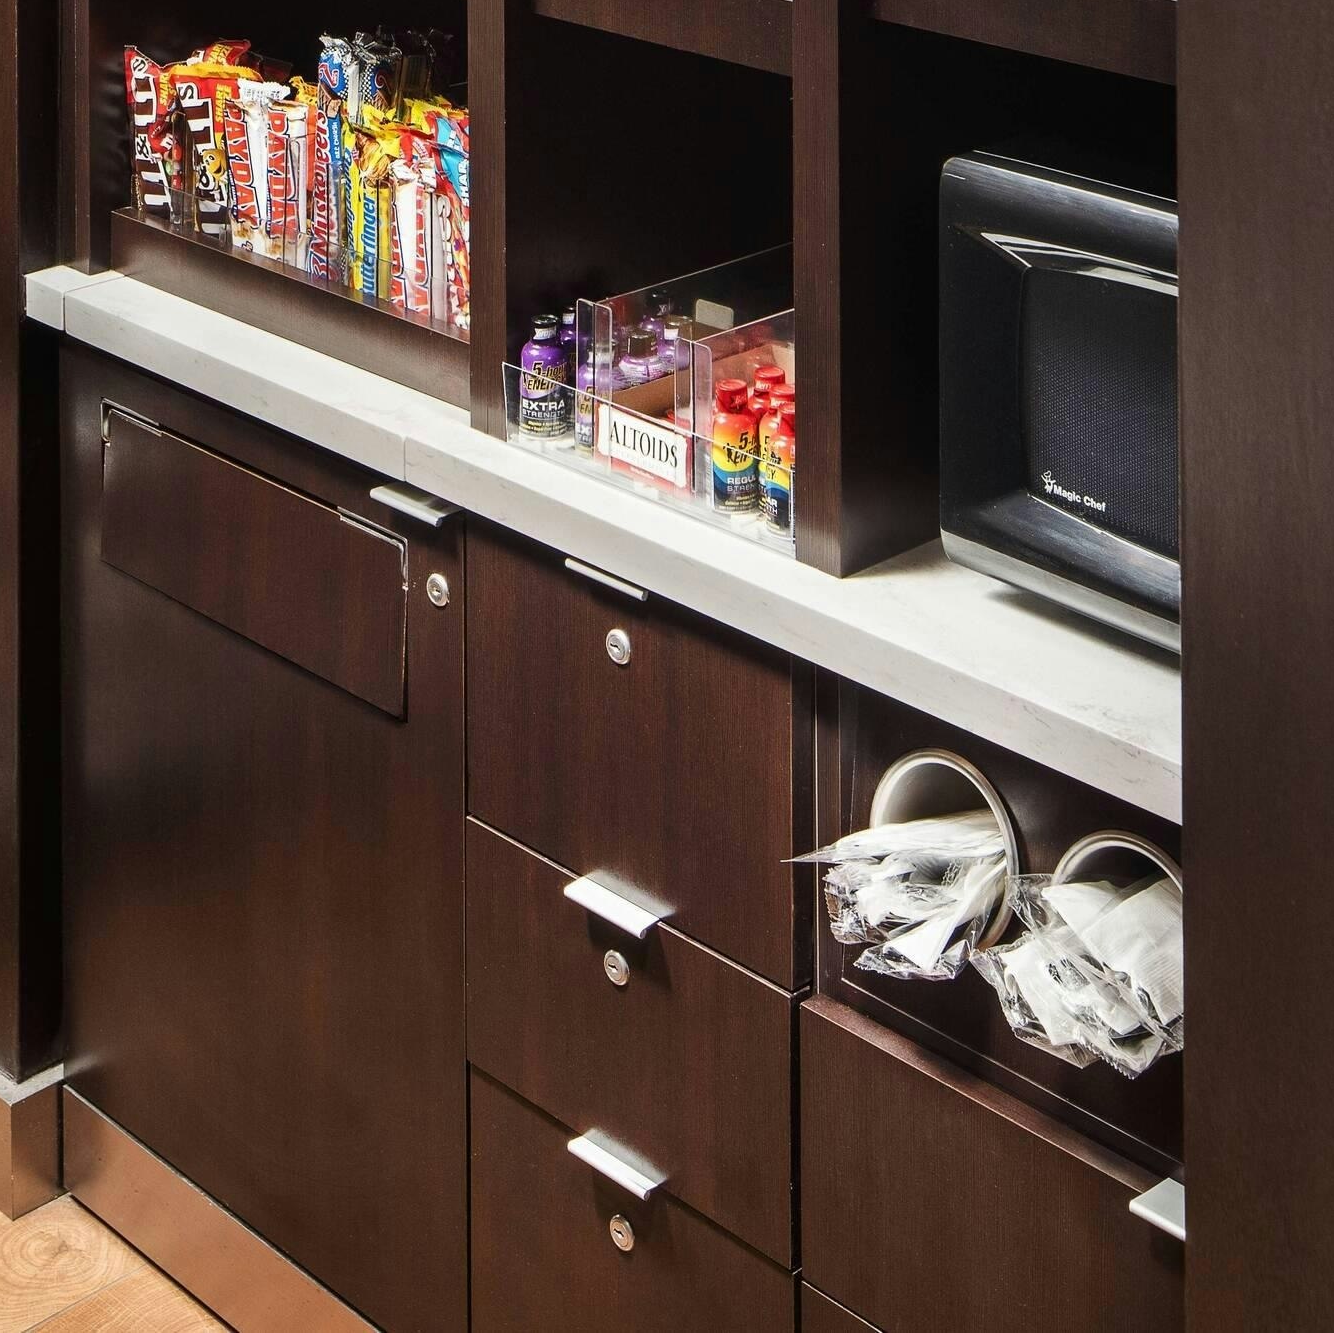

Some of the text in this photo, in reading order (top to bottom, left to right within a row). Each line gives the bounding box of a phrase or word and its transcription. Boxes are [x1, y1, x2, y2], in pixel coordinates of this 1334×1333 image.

[224, 99, 262, 229] PAYDAY
[267, 106, 299, 240] PAYDAY
[362, 193, 378, 297] utterfinger
[522, 398, 565, 411] EXTRA
[522, 408, 565, 418] STRENGTH
[609, 420, 679, 469] ALTOIDS
[1053, 484, 1106, 512] Magic Chef
